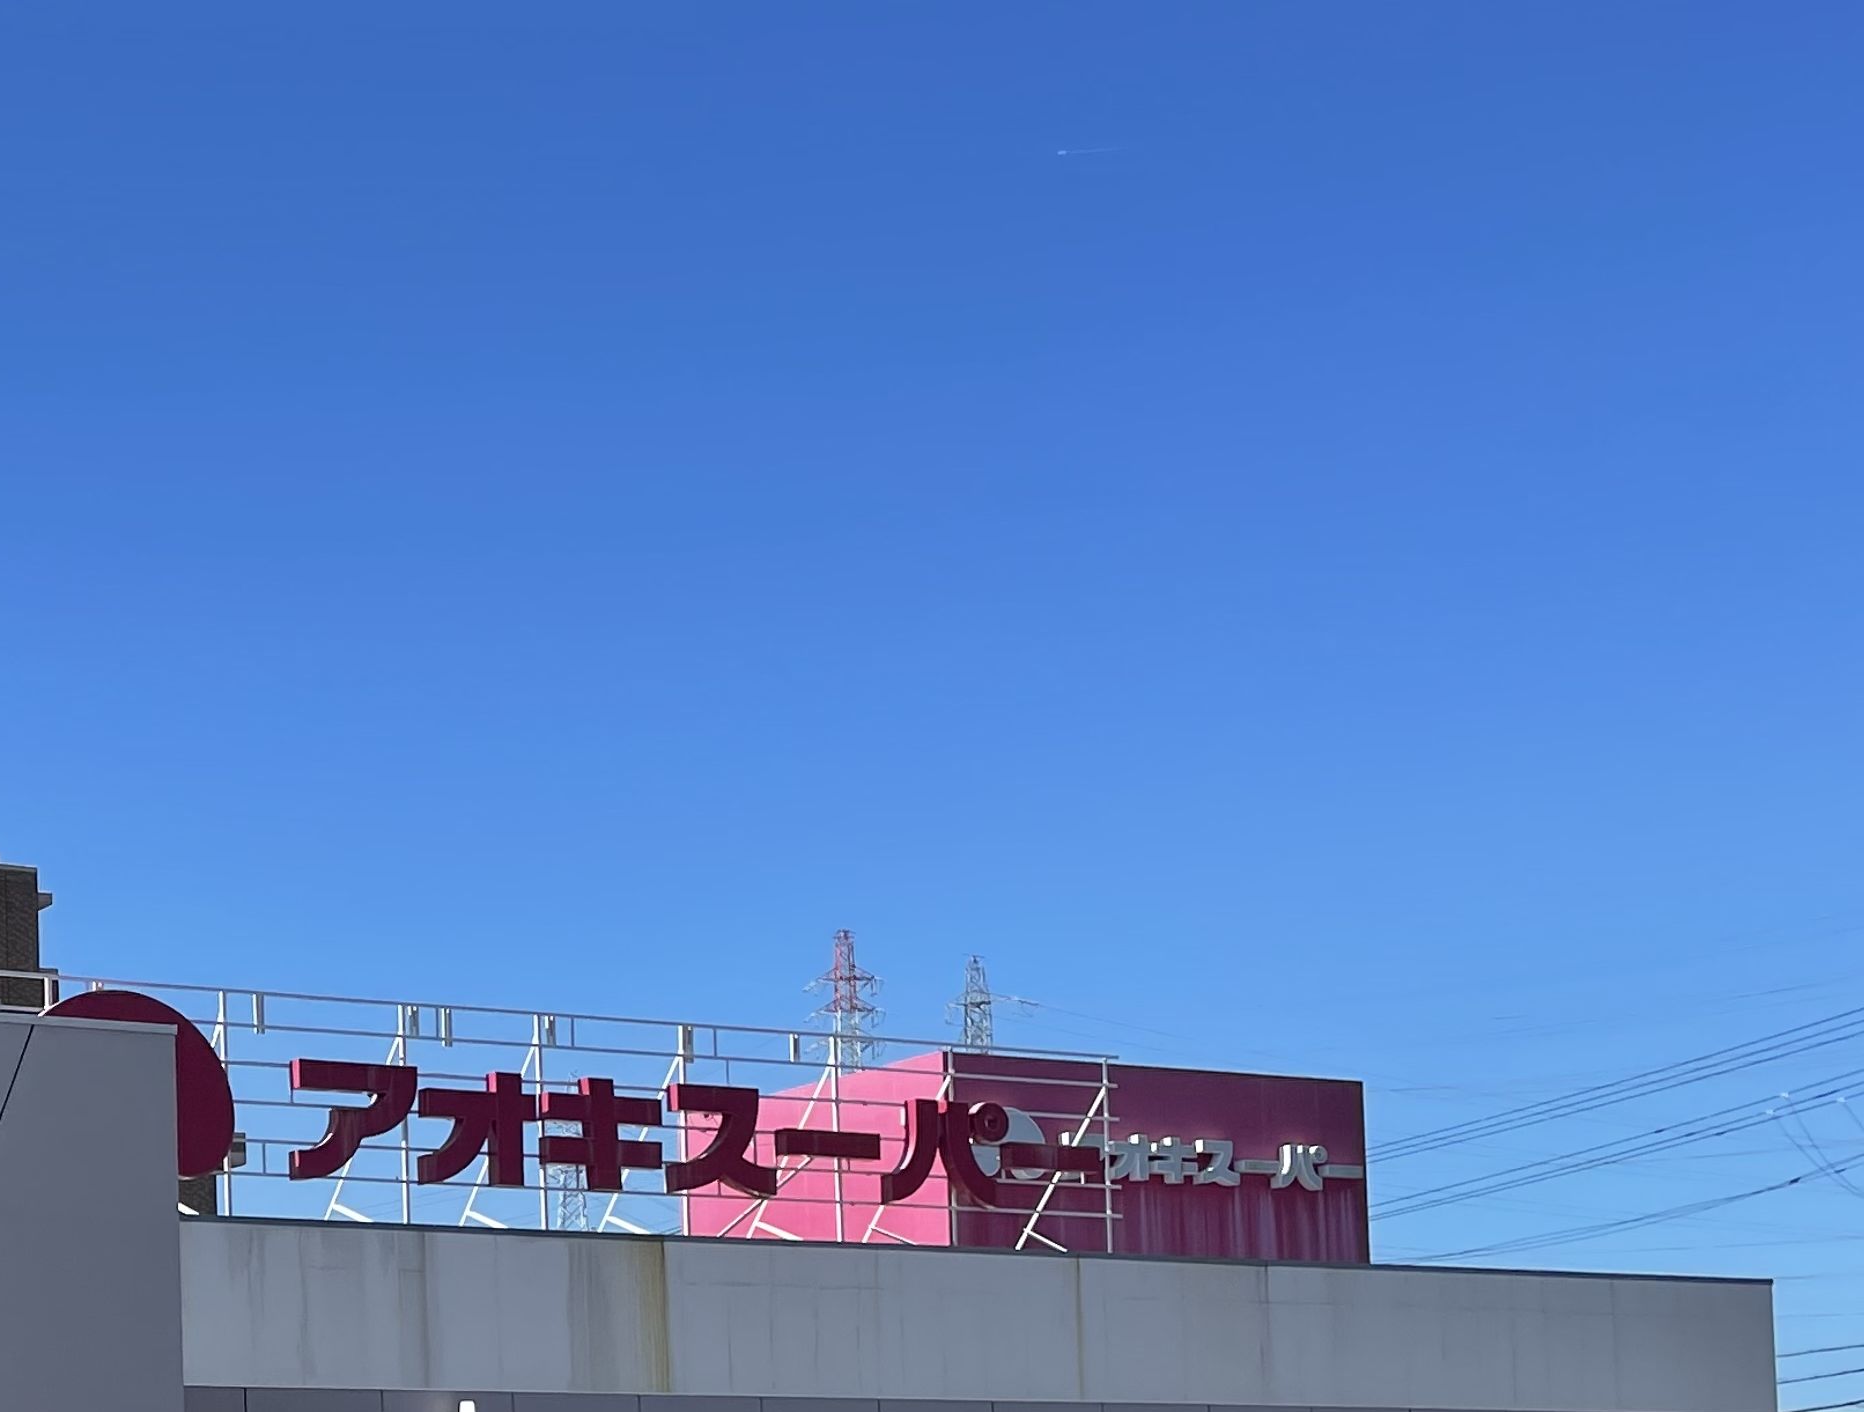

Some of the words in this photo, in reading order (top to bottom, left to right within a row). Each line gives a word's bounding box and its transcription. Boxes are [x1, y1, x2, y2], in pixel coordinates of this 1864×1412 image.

[289, 1058, 1102, 1208] アオキスーパー
